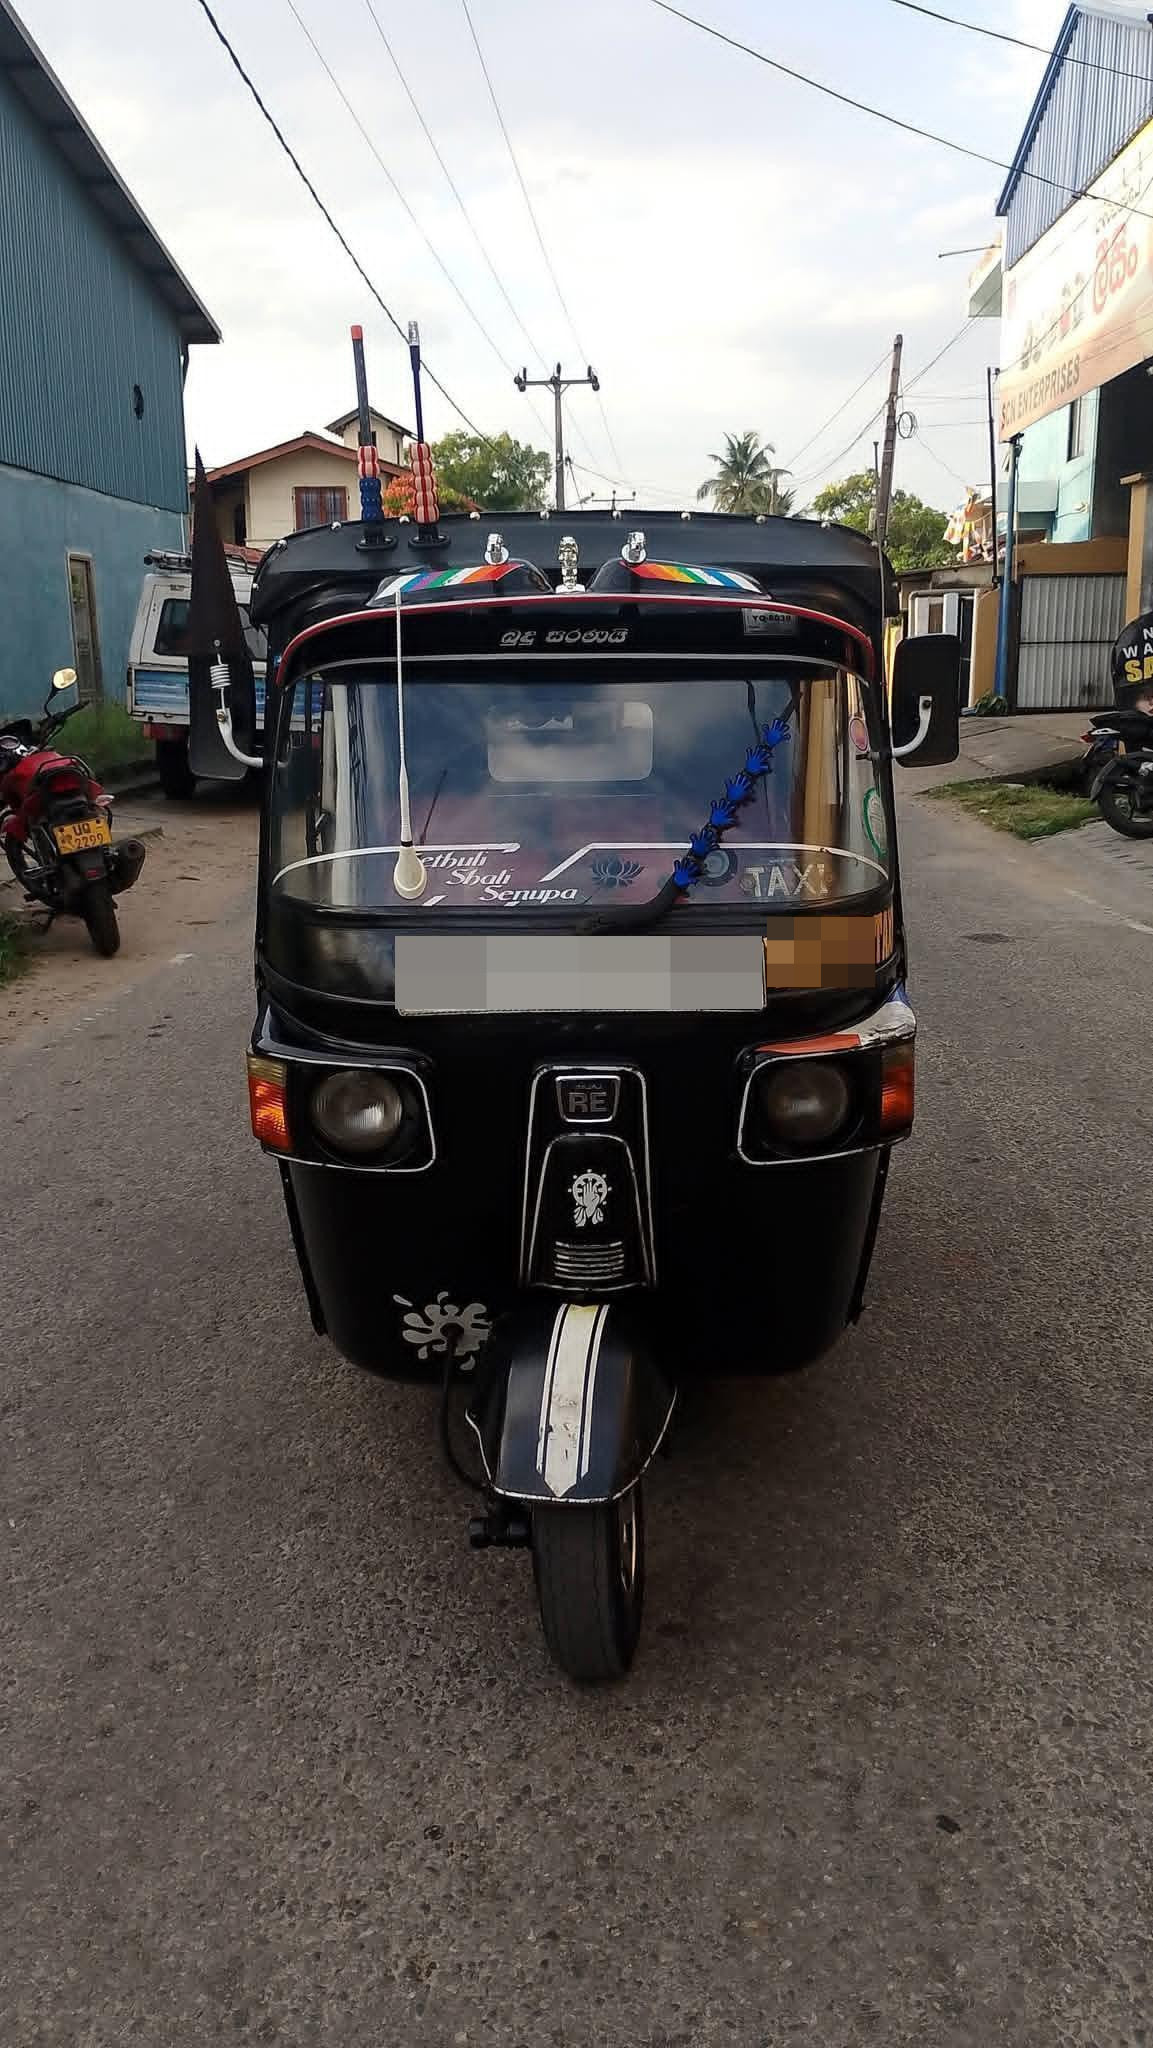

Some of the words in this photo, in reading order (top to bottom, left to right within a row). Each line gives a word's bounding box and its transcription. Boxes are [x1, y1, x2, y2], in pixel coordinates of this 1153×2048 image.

[1018, 353, 1081, 420] ENTERPRISES
[415, 850, 488, 869] ethuli
[446, 868, 515, 886] Shali
[745, 863, 829, 897] TAXI
[480, 885, 579, 904] Senupa
[568, 1091, 607, 1113] RE
